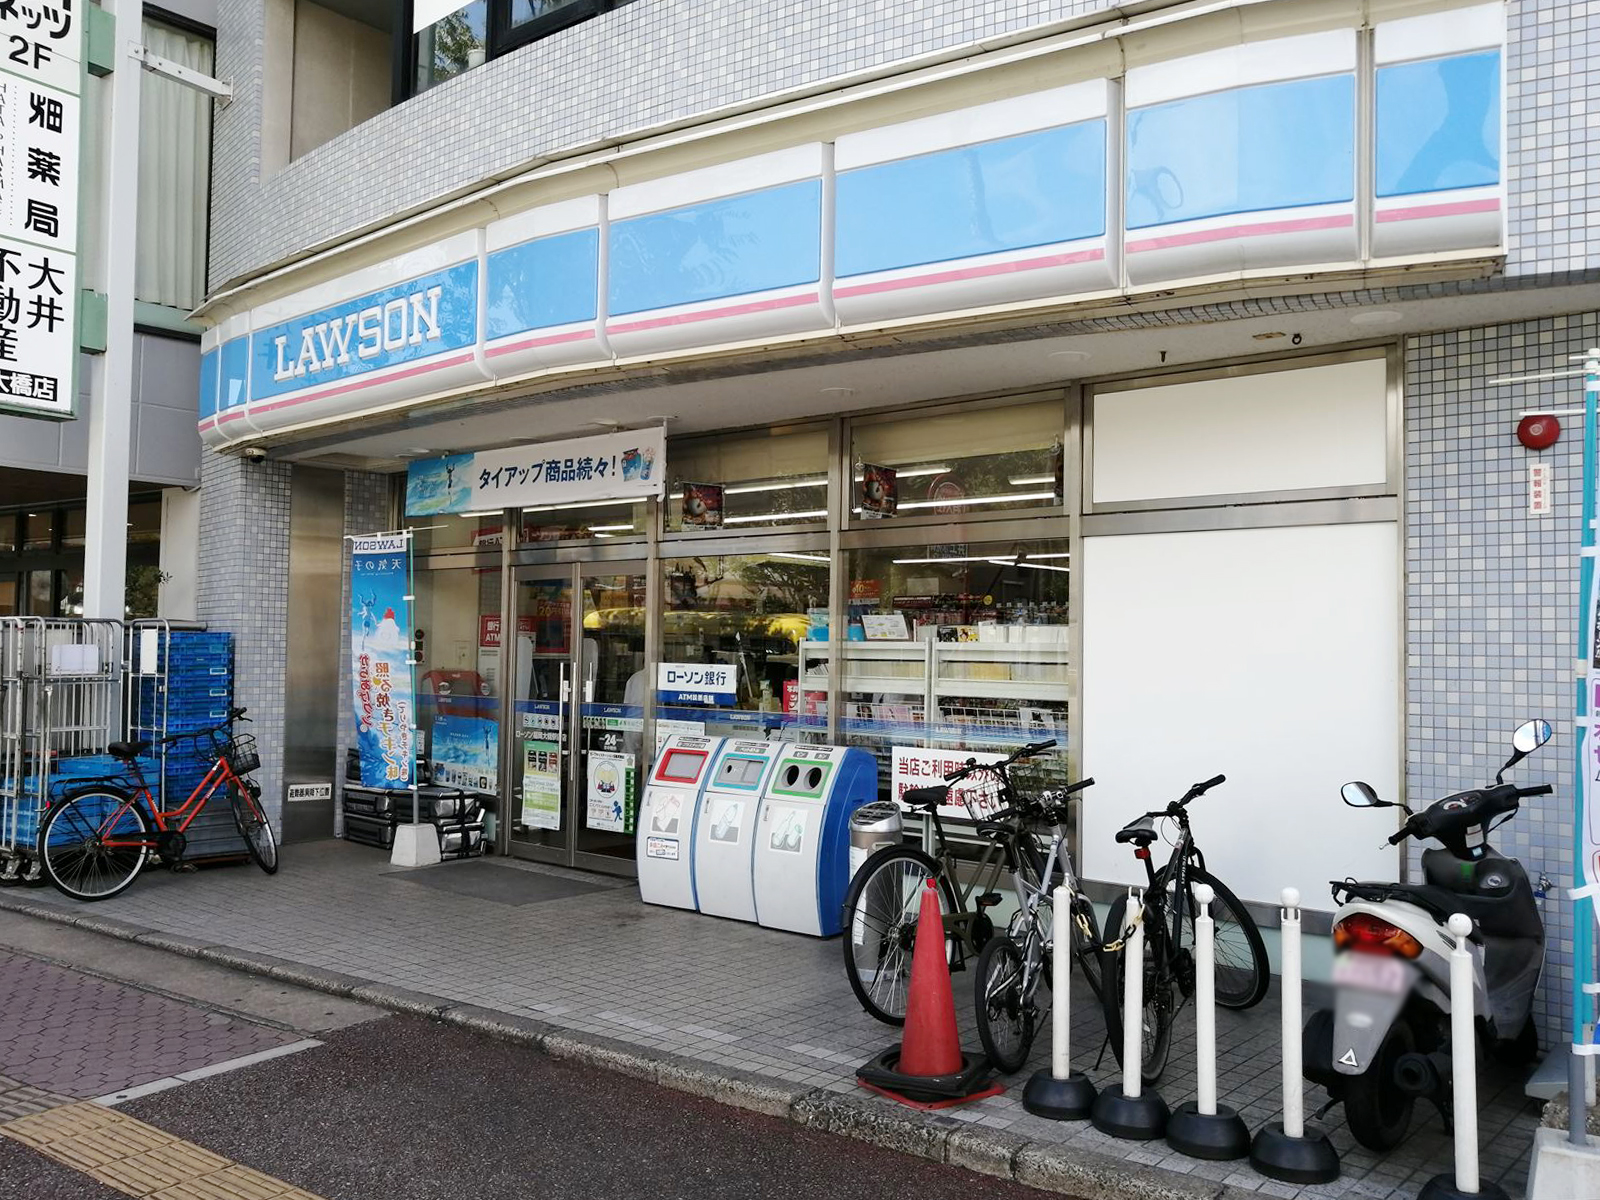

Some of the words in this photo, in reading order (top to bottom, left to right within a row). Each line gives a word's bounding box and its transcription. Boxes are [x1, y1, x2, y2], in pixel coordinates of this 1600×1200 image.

[9, 34, 53, 70] 2F
[24, 91, 63, 239] 畑薬局
[27, 256, 65, 333] 大井
[273, 285, 443, 383] LAWSON
[479, 455, 617, 490] タイアップ商品続々!
[667, 670, 727, 686] ローソン銀行
[604, 733, 617, 746] 24
